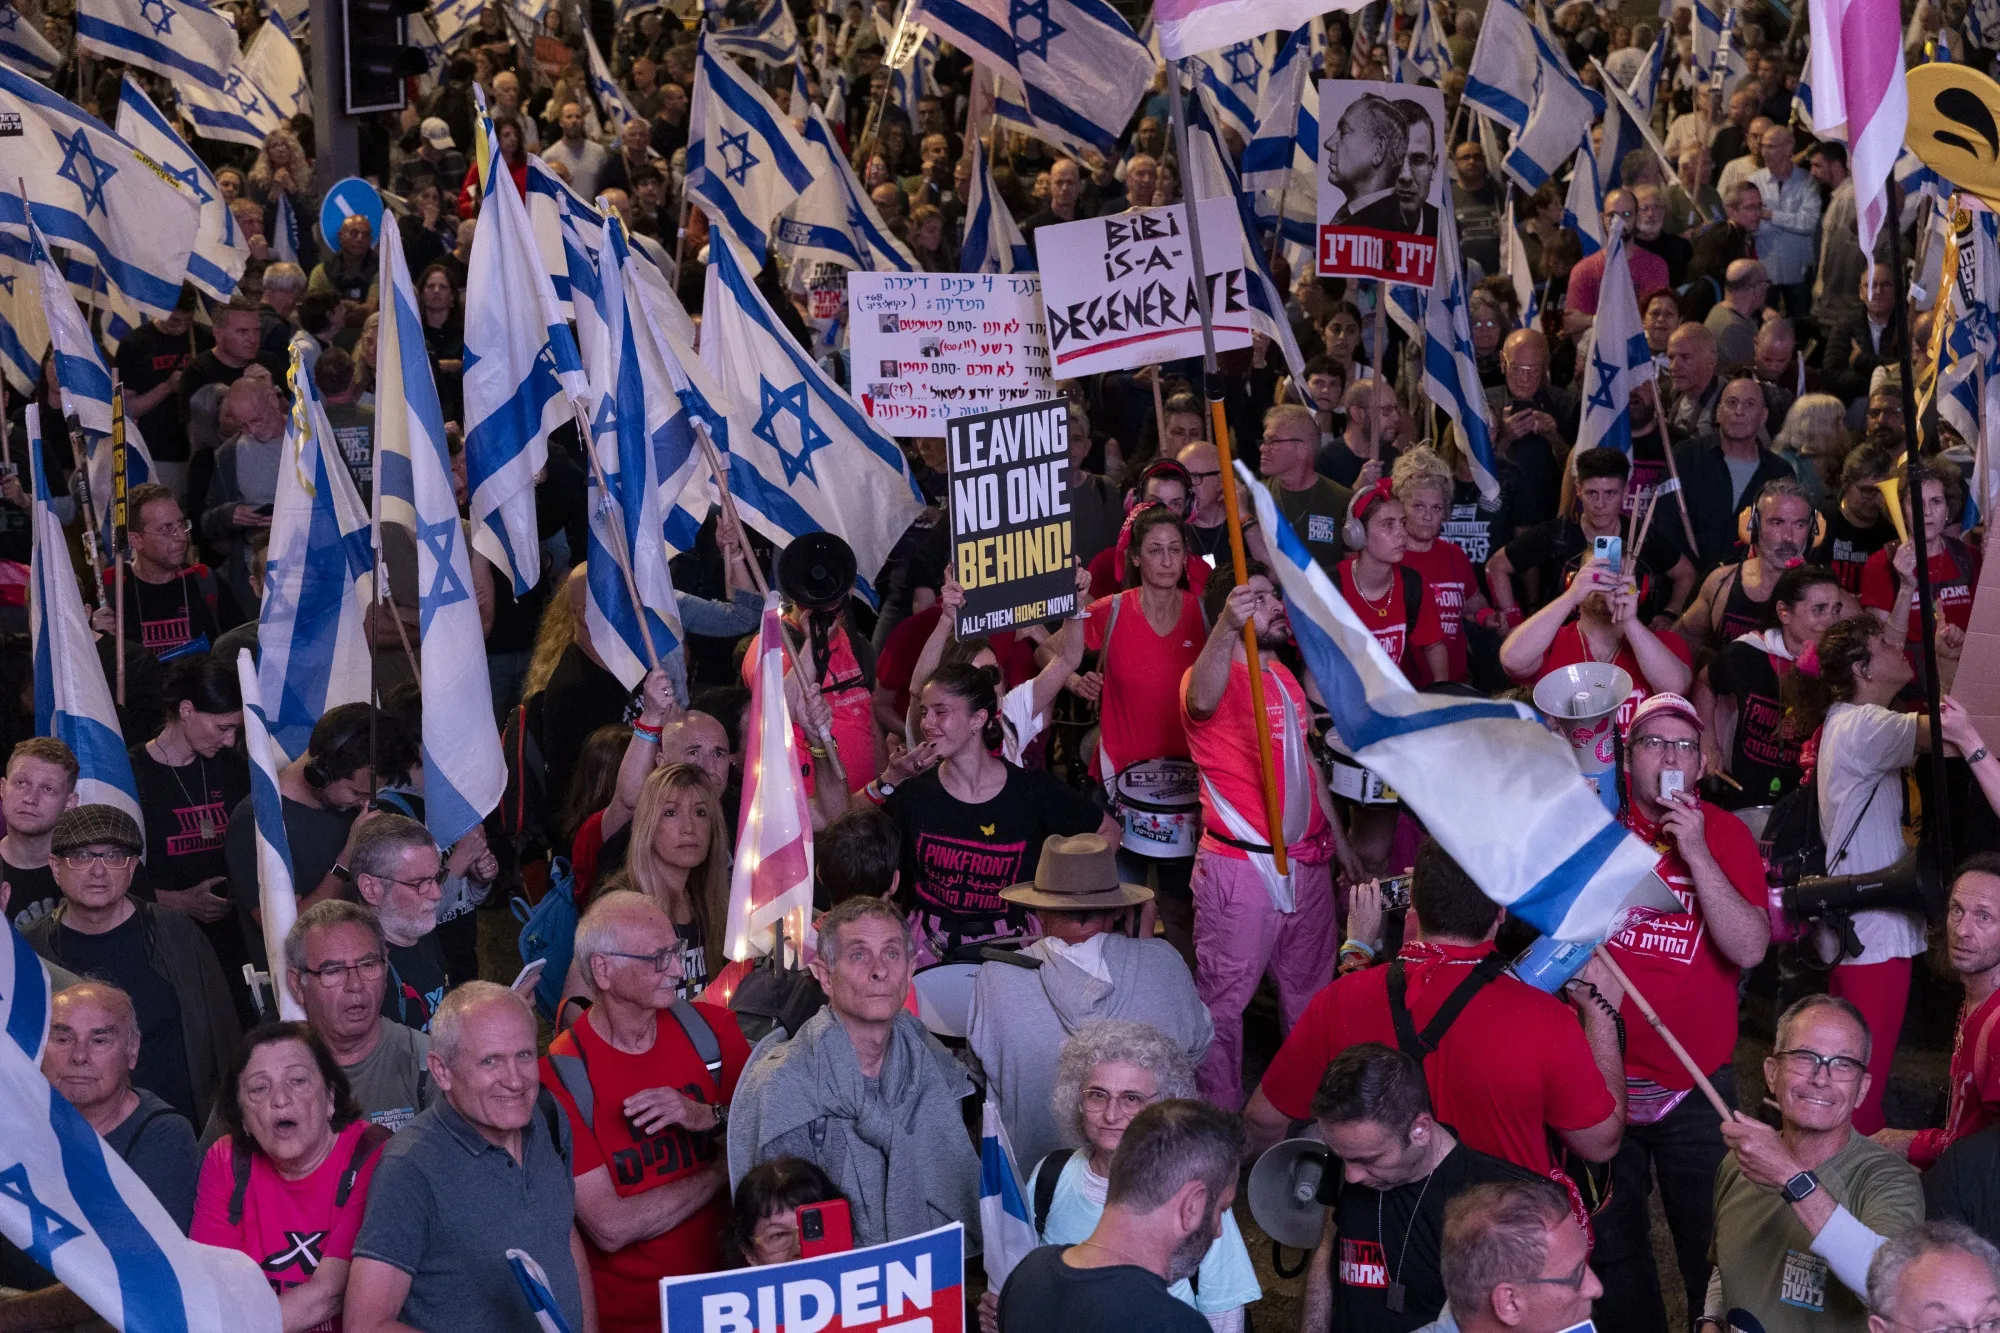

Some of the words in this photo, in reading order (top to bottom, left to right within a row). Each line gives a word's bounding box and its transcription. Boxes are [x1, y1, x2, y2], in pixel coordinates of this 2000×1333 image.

[982, 275, 993, 292] 4
[1046, 268, 1248, 350] DEGENERATE
[951, 407, 1068, 473] LEAVING
[954, 473, 1000, 535] NO
[1007, 458, 1071, 525] ONE
[958, 521, 1072, 591] BEHIND!
[961, 616, 981, 635] ALL
[986, 608, 1014, 630] THEM
[1014, 599, 1047, 623] HOME!
[1047, 594, 1074, 616] NOW!
[924, 842, 1015, 877] PINKFRONT
[1639, 932, 1689, 955] החזית
[702, 1253, 932, 1333] BIDEN
[1781, 1279, 1825, 1307] לנשק
